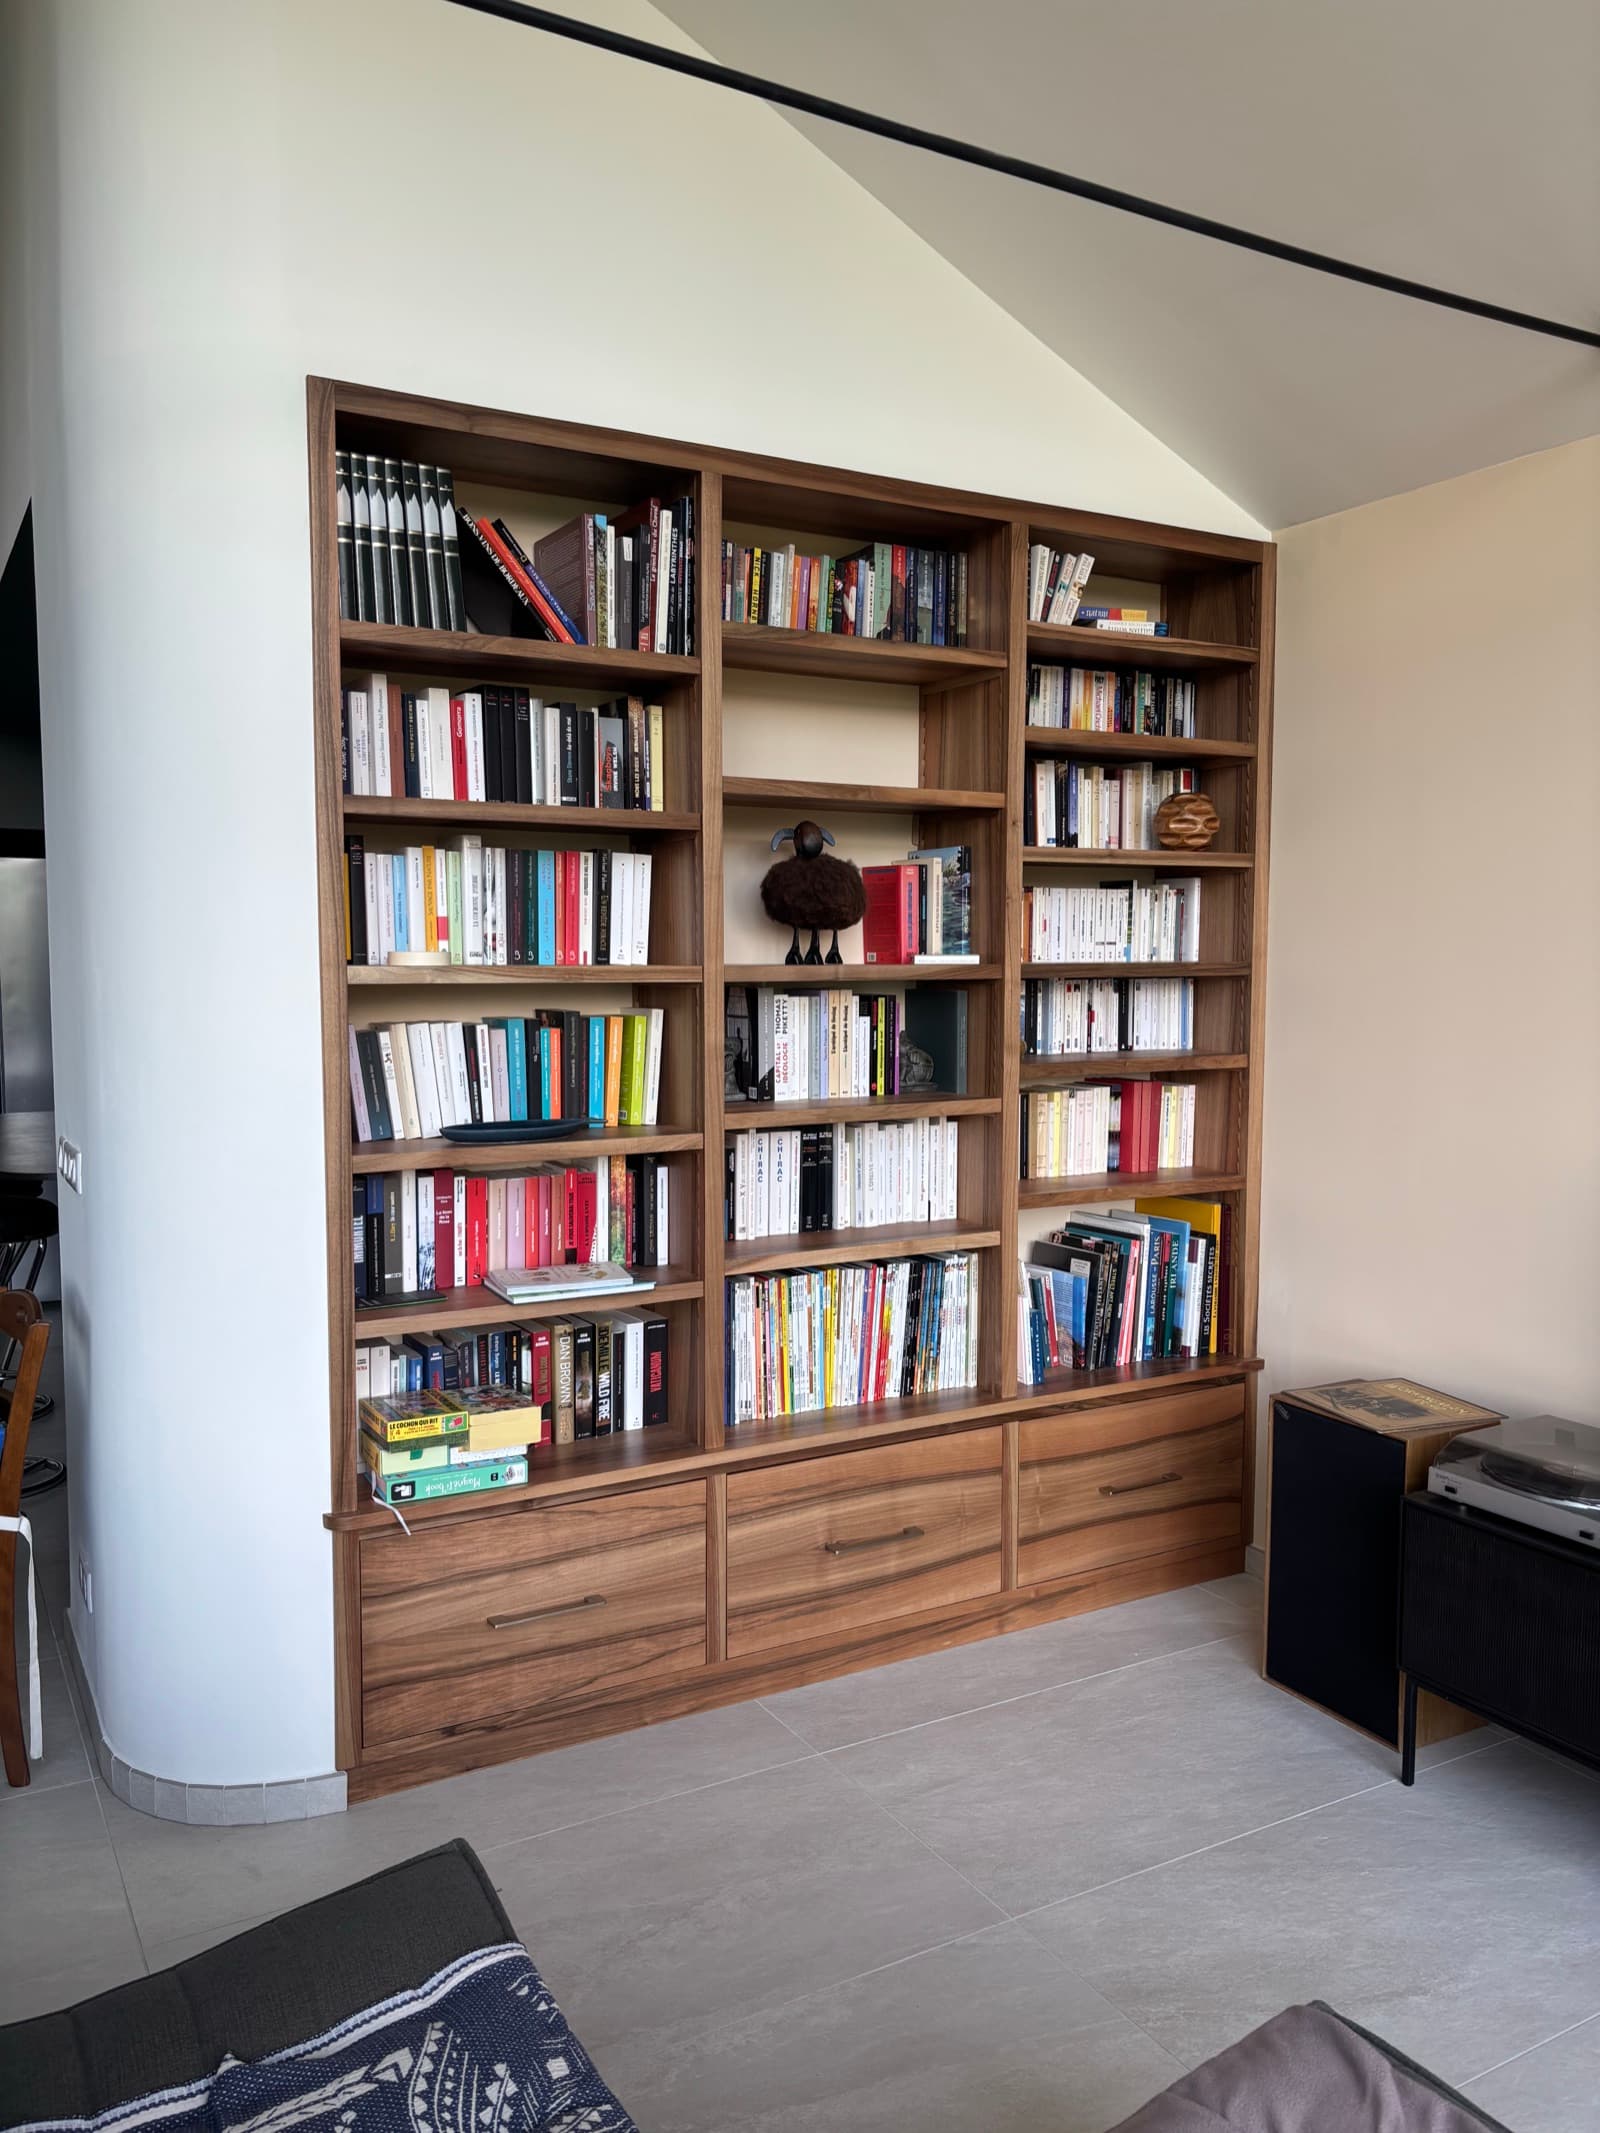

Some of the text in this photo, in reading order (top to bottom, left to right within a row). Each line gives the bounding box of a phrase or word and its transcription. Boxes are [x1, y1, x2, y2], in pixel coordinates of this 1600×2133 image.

[670, 528, 678, 584] LABYRINTHES
[498, 563, 530, 607] BORDEAUX
[751, 589, 759, 621] HORNB
[604, 746, 612, 792] Skagboys
[353, 1215, 364, 1263] IMMORTEL
[1149, 1236, 1161, 1314] LAROUSSE PARIS
[1170, 1240, 1178, 1289] IRLANDE
[560, 1336, 571, 1404] DAN BROWN
[598, 1326, 610, 1422] DEMILLE WILD FIRE
[650, 1351, 662, 1393] VATICANUM
[396, 1420, 418, 1429] COCHON
